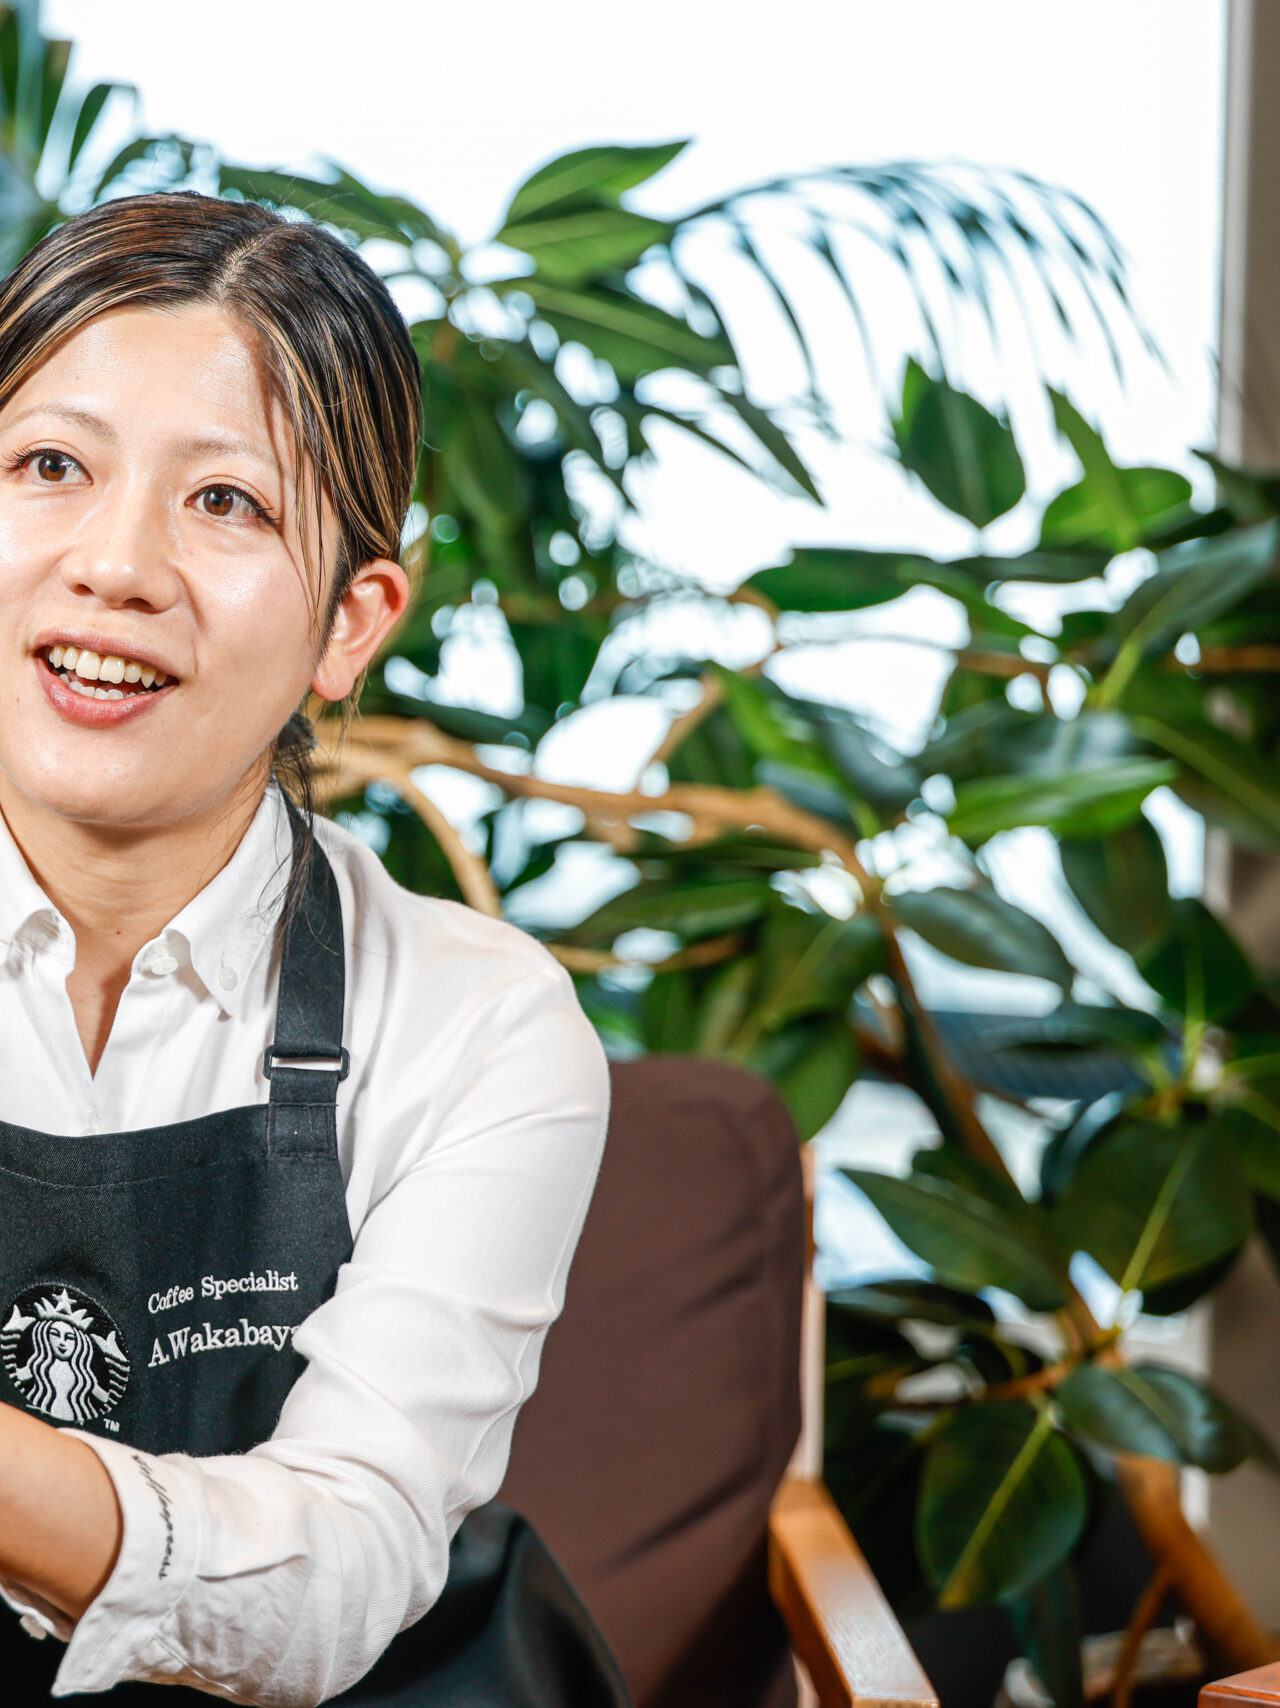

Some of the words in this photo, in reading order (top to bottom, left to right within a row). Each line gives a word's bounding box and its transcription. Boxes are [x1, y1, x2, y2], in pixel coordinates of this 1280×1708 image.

[148, 1285, 195, 1314] Coffee
[201, 1270, 299, 1300] Specialist
[103, 1417, 120, 1432] TM
